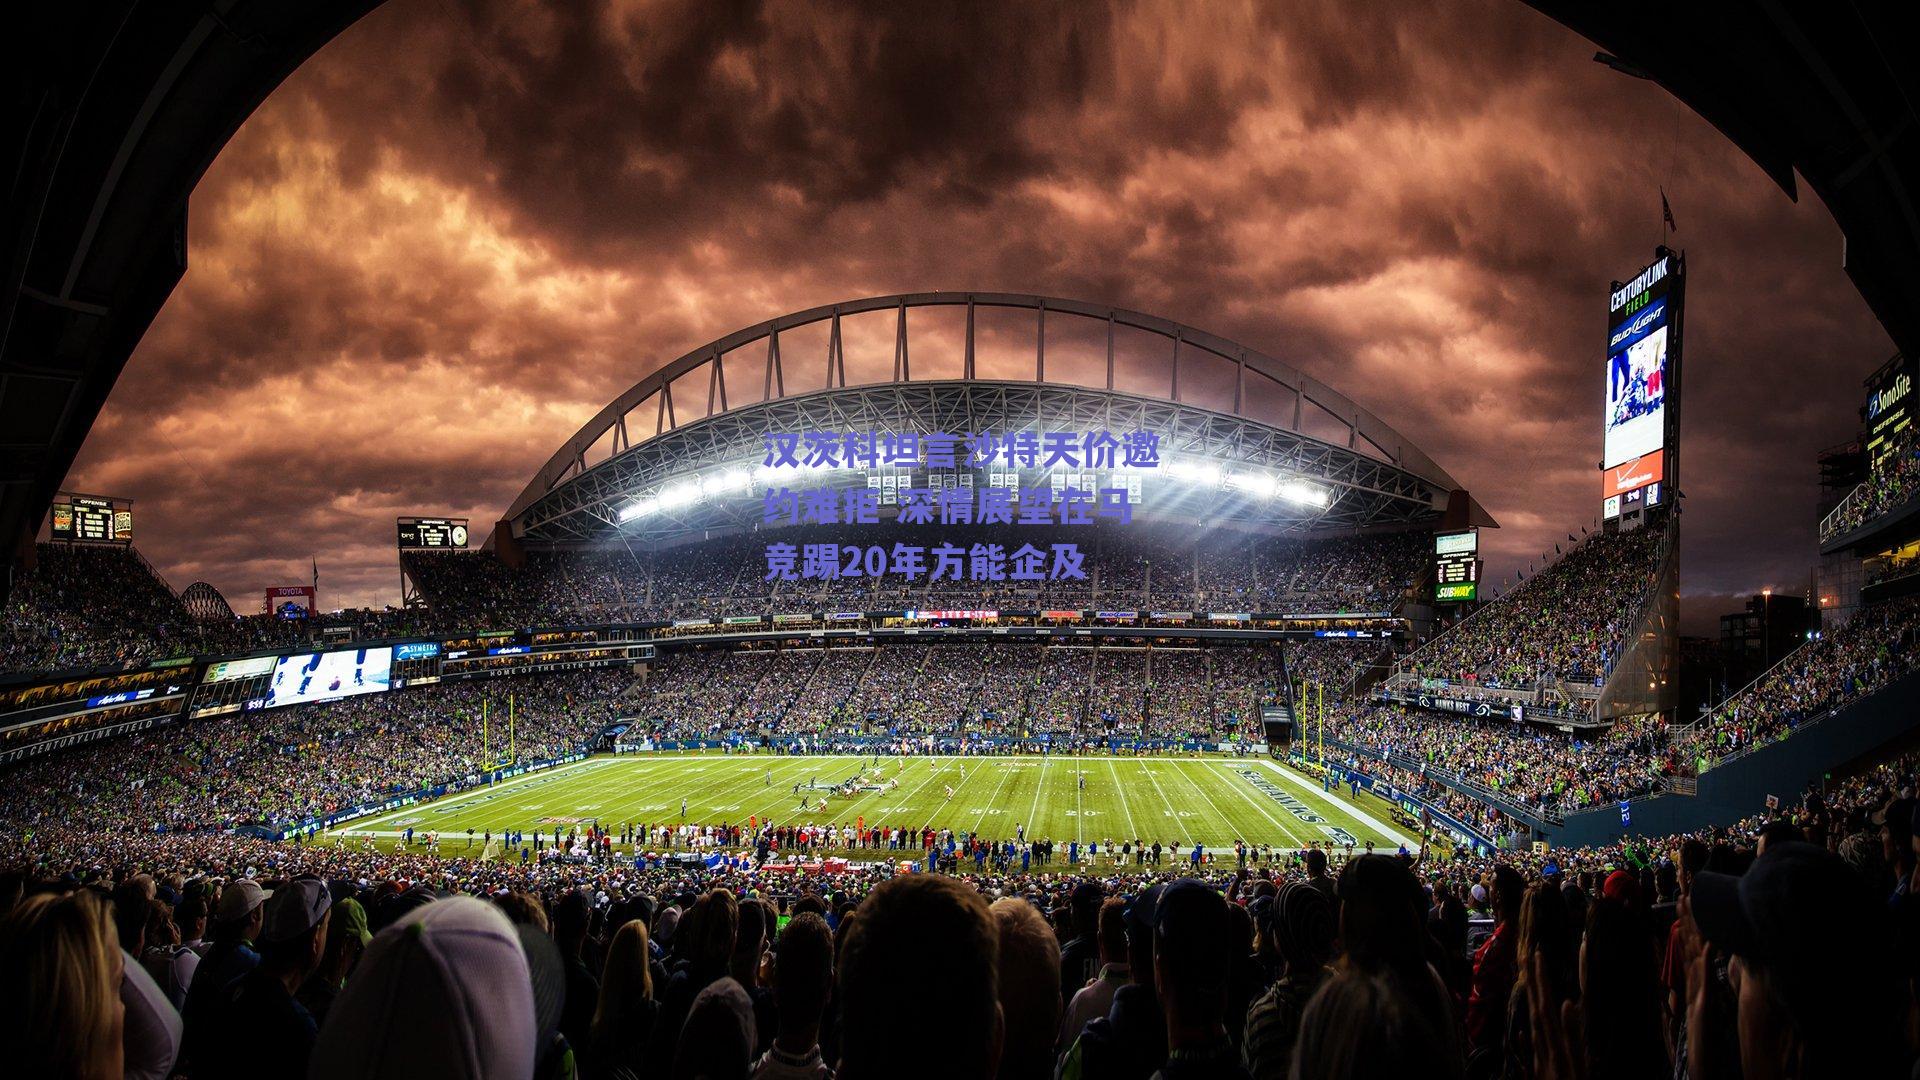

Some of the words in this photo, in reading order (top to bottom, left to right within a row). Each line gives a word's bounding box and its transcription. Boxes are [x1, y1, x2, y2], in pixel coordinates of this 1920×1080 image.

[1611, 256, 1669, 312] CENTURYLINK
[1625, 290, 1650, 316] FIELD
[1610, 327, 1633, 346] BUD
[1634, 305, 1665, 331] LIGHT
[1877, 373, 1911, 414] SonoSite
[80, 499, 107, 507] OFFENSE
[279, 587, 303, 596] TOYOTA
[1437, 585, 1474, 599] SUBWAY
[490, 669, 516, 677] HOME
[538, 664, 555, 672] THE
[590, 660, 609, 668] MAN
[1434, 699, 1454, 711] HAWKS
[10, 749, 23, 762] TO
[30, 728, 111, 757] CENTURYLINK
[118, 720, 153, 735] FIELD
